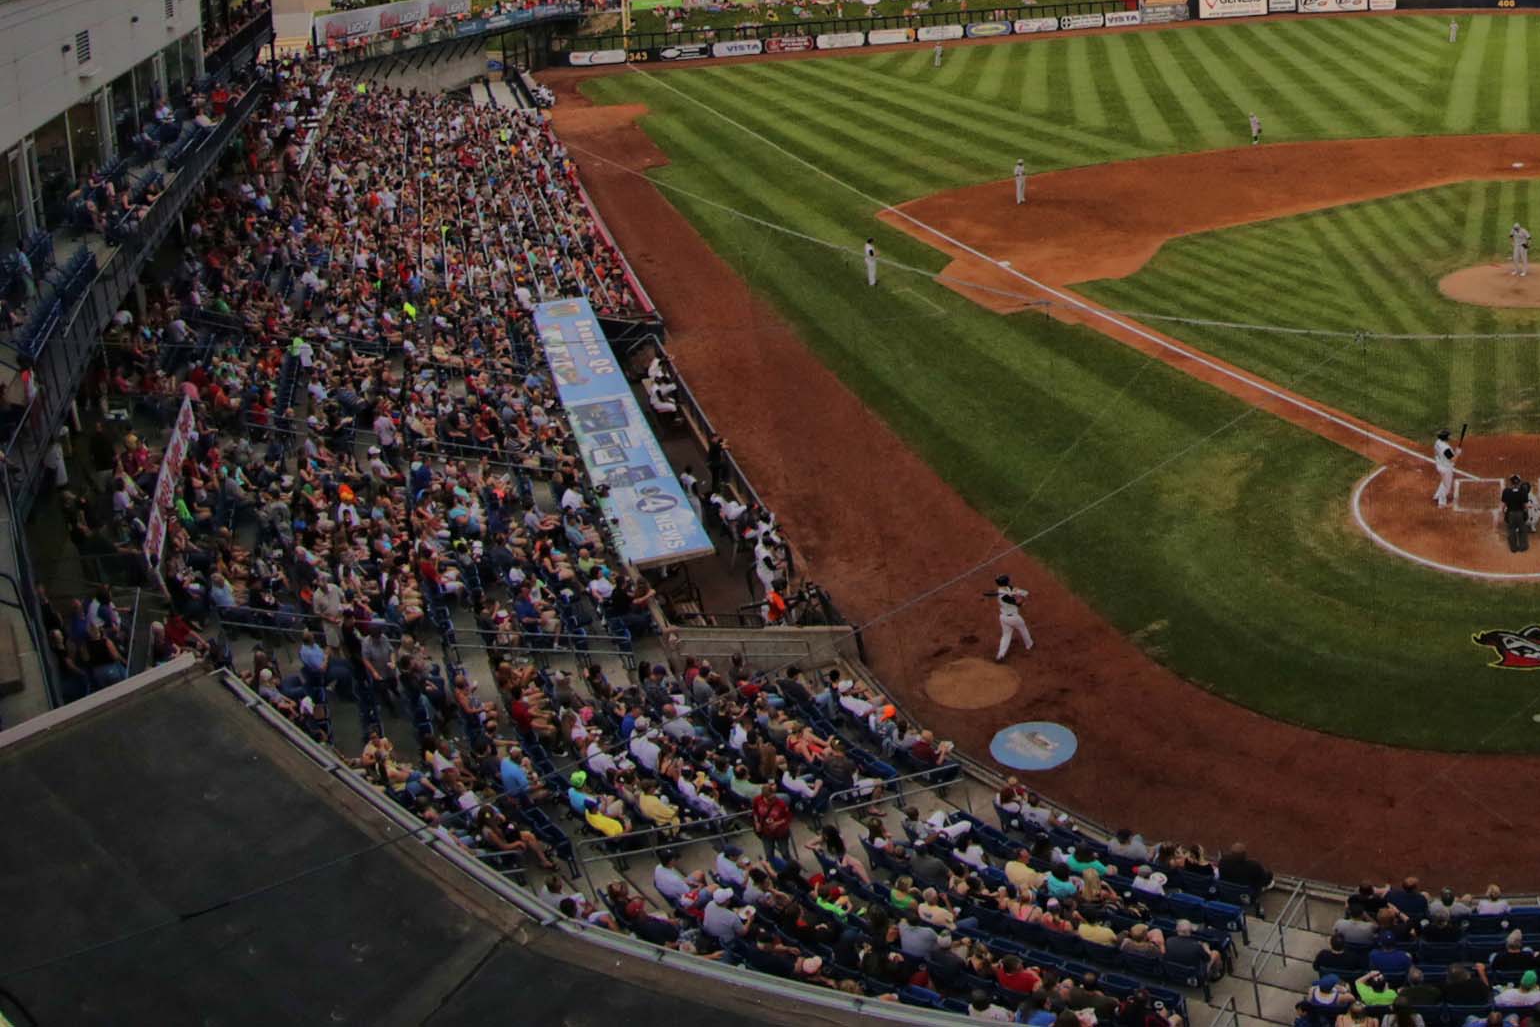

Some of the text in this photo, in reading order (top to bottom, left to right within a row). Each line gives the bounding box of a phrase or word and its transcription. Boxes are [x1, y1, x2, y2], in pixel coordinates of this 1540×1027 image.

[1108, 15, 1138, 23] VISTA
[726, 44, 760, 52] VISTA
[628, 51, 648, 62] 343
[655, 513, 686, 550] NEWS
